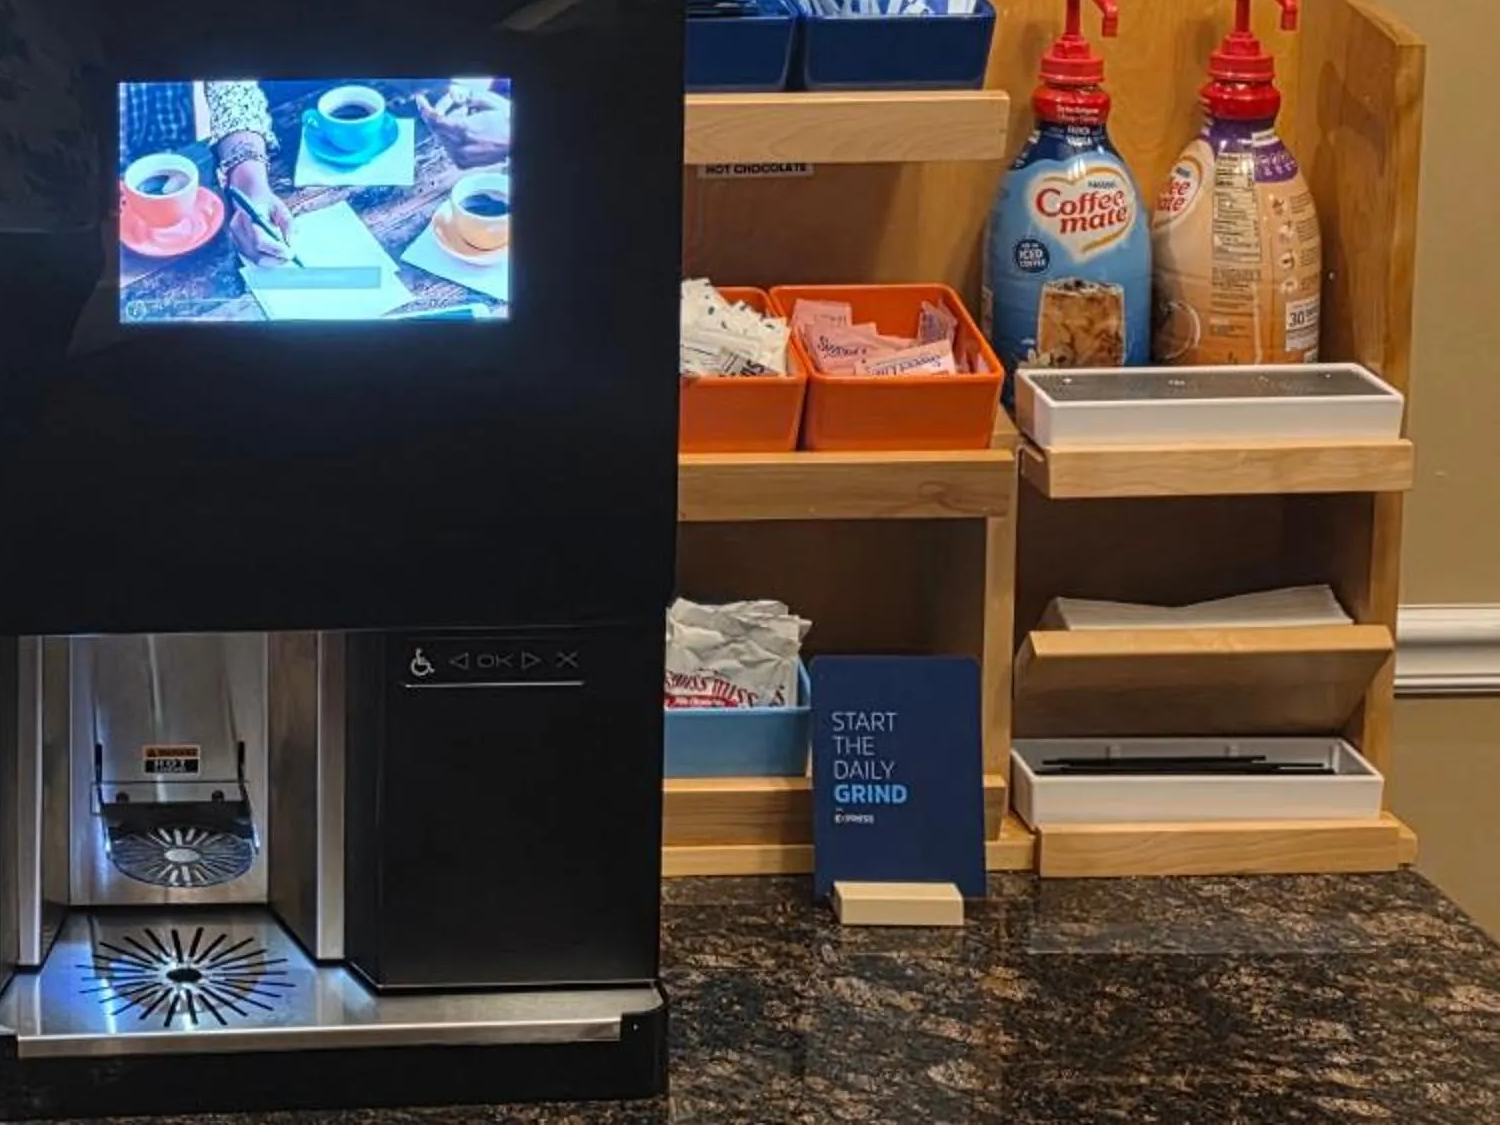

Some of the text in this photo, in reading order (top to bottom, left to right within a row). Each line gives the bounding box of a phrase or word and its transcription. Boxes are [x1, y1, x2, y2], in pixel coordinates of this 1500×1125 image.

[706, 162, 807, 175] HOT CHOCOLATE
[1036, 188, 1125, 217] Coffee
[1060, 207, 1128, 234] mate
[831, 712, 898, 731] START
[833, 736, 874, 755] THE
[834, 760, 895, 780] DAILY
[834, 783, 908, 804] GRIND
